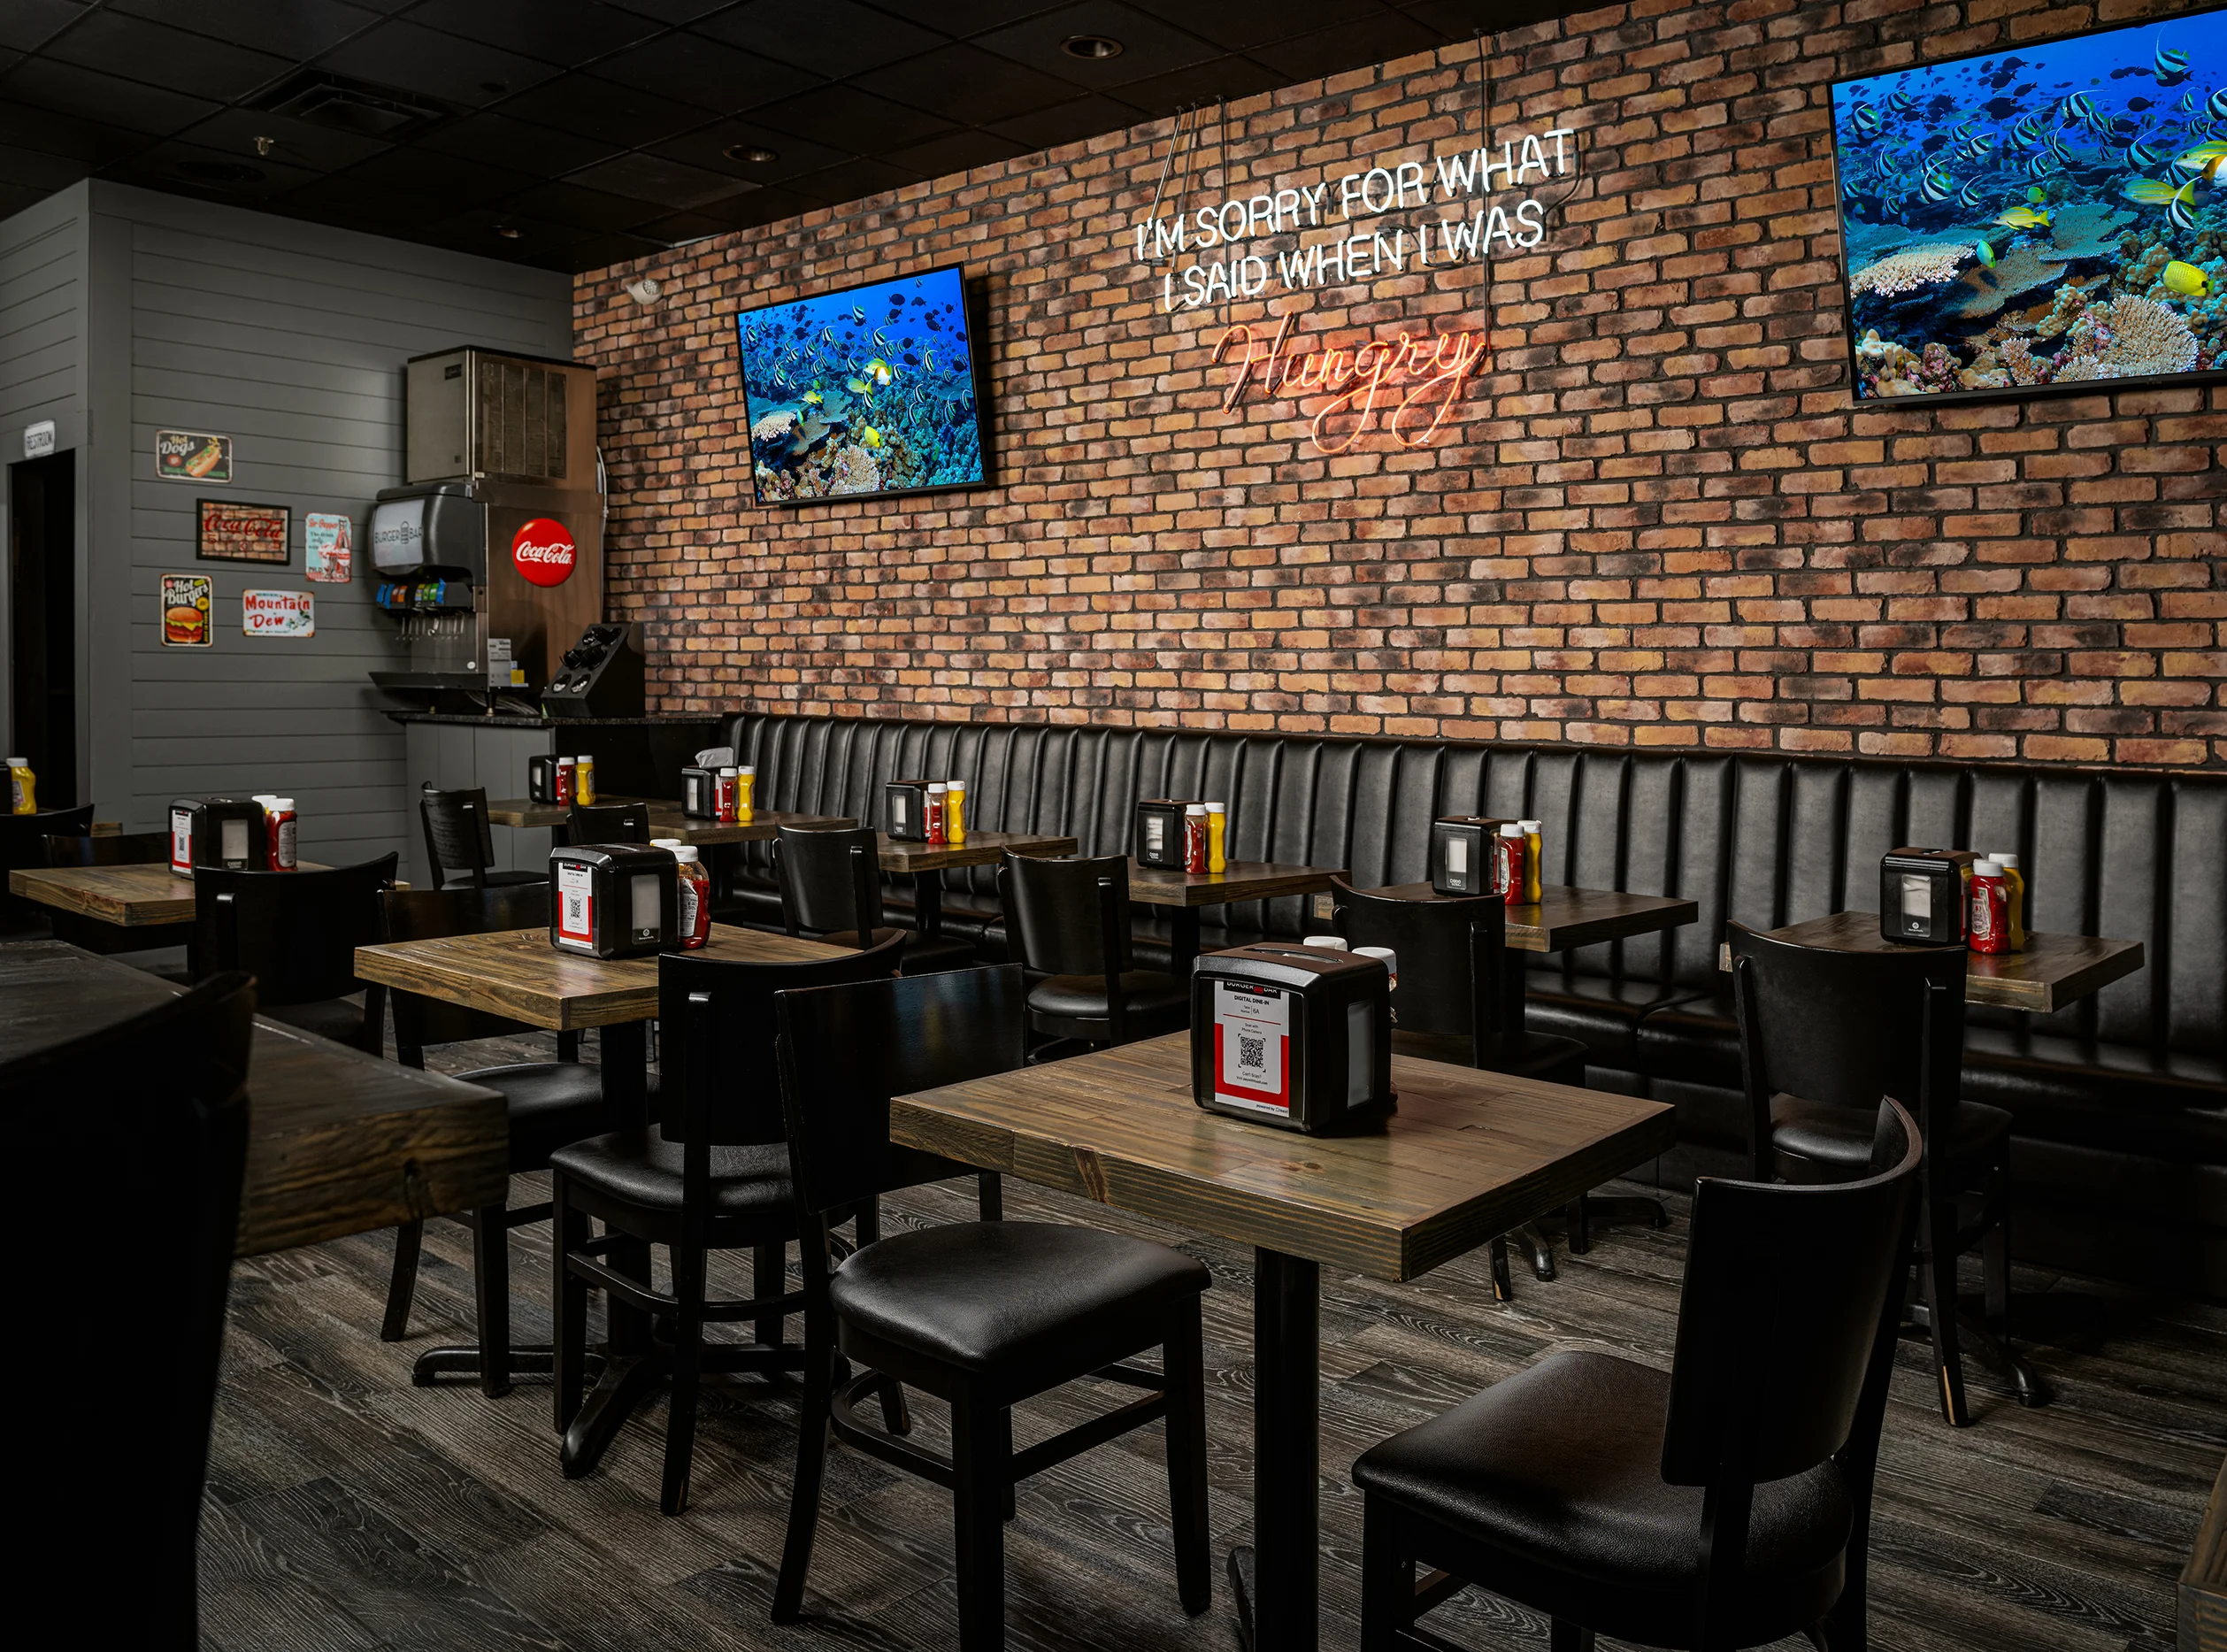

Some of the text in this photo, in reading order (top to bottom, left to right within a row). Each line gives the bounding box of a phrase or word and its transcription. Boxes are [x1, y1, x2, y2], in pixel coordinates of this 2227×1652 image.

[1137, 127, 1575, 261] I'M SORRY FOR WHAT
[1163, 198, 1544, 312] I SAID WHEN I WAS
[1211, 311, 1487, 454] Hungry
[160, 441, 196, 457] Dogs
[374, 529, 400, 544] BURGER
[516, 541, 575, 565] Coca-Cola
[165, 584, 209, 607] Burgers
[173, 579, 194, 593] Hot
[245, 595, 311, 611] Mountain
[249, 614, 285, 628] Dew
